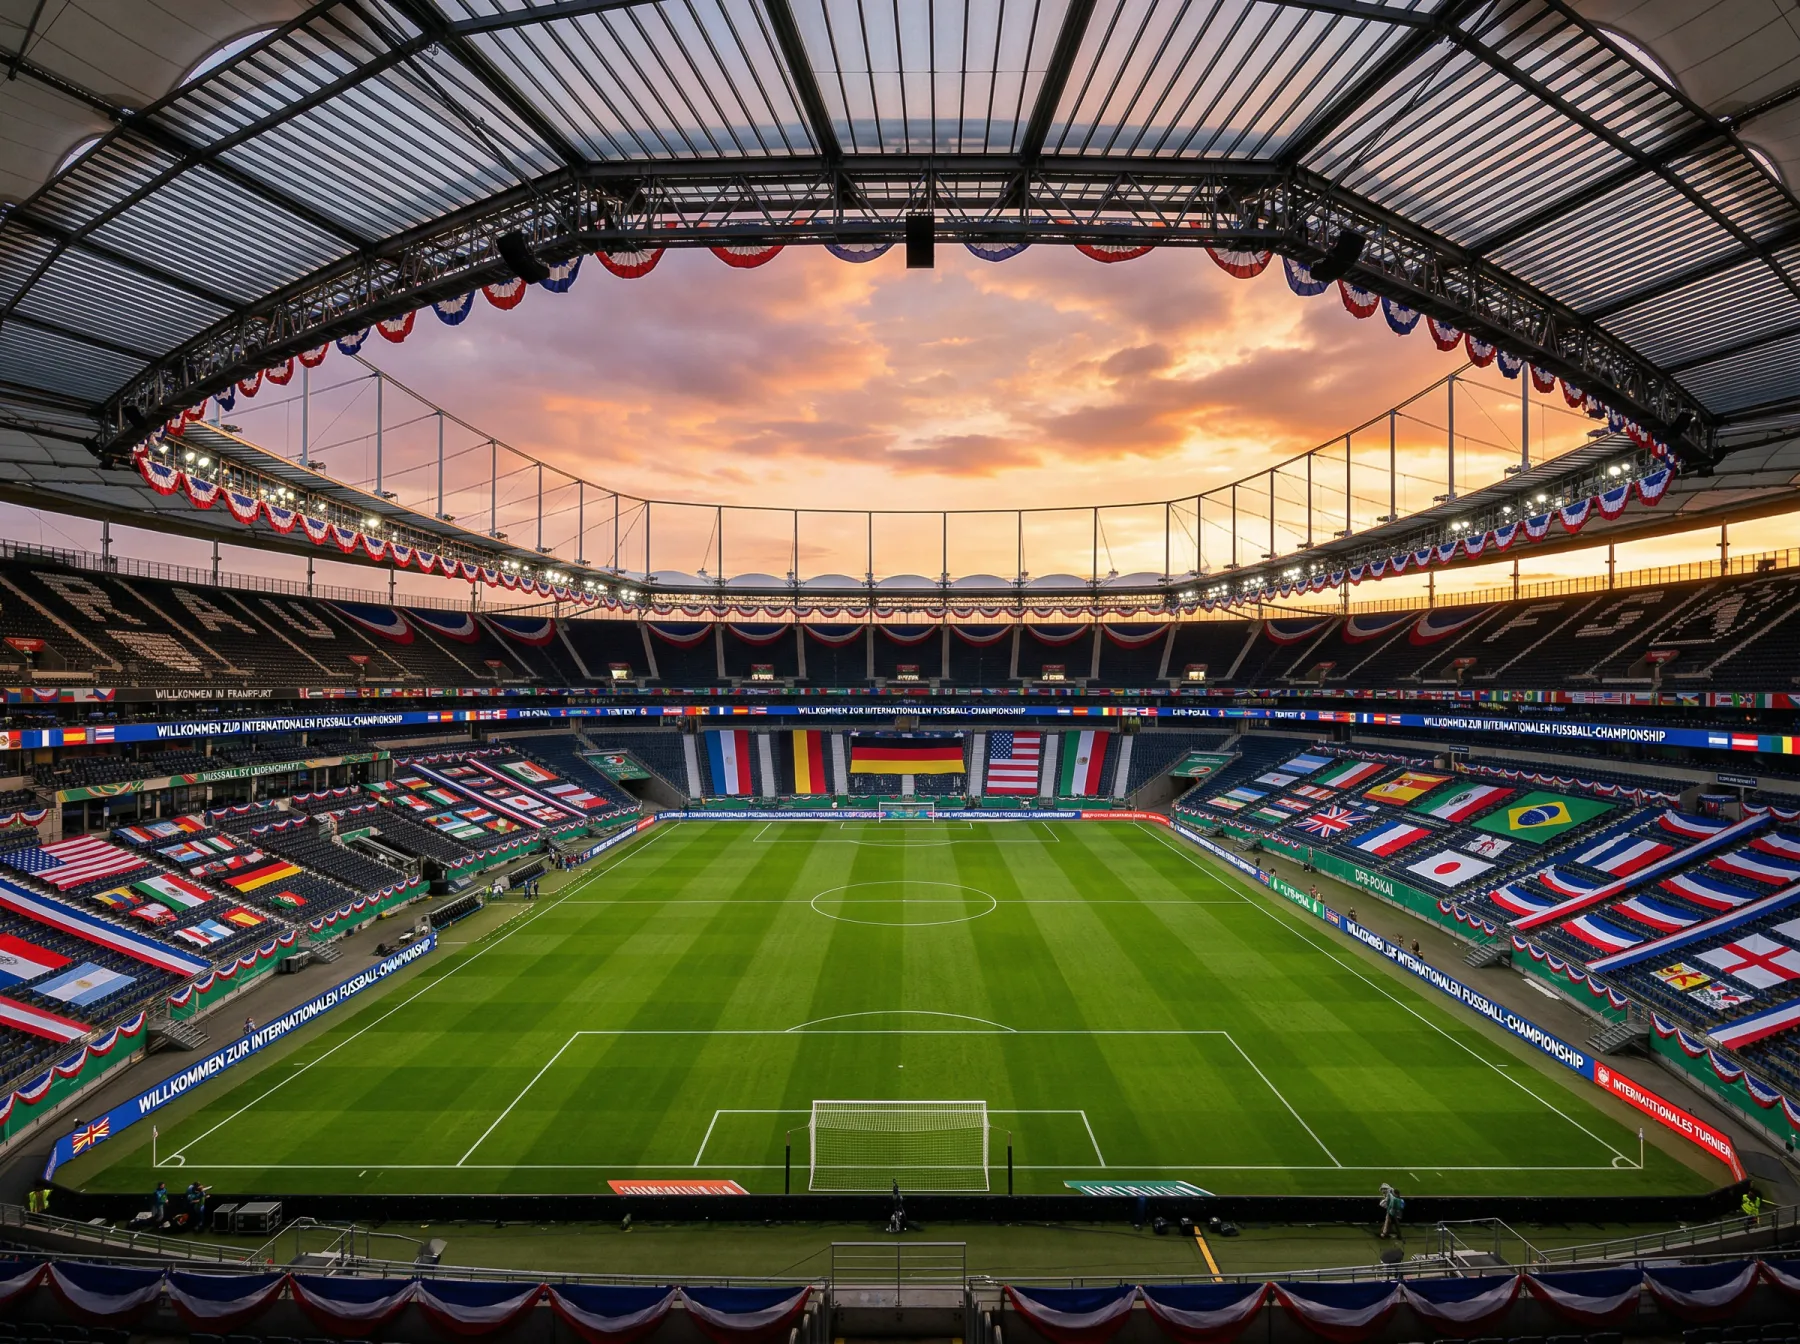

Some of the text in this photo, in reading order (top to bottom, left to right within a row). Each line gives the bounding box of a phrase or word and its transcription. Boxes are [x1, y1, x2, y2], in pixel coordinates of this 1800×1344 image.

[215, 689, 224, 698] IN
[157, 722, 221, 737] WILLKOMMEN
[241, 718, 315, 732] INTERNATIONALEN
[1552, 724, 1666, 742] FUSSBALL-CHAMPIONSHIP
[1355, 868, 1394, 897] DFB-POKAL
[1462, 987, 1584, 1069] FUSSBALL-CHAMPIONSHIP
[138, 1053, 225, 1114] WILLKOMMEN
[226, 1038, 250, 1064] ZUR
[251, 989, 338, 1050] INTERNATIONALEN
[1694, 1125, 1731, 1159] TURNIER
